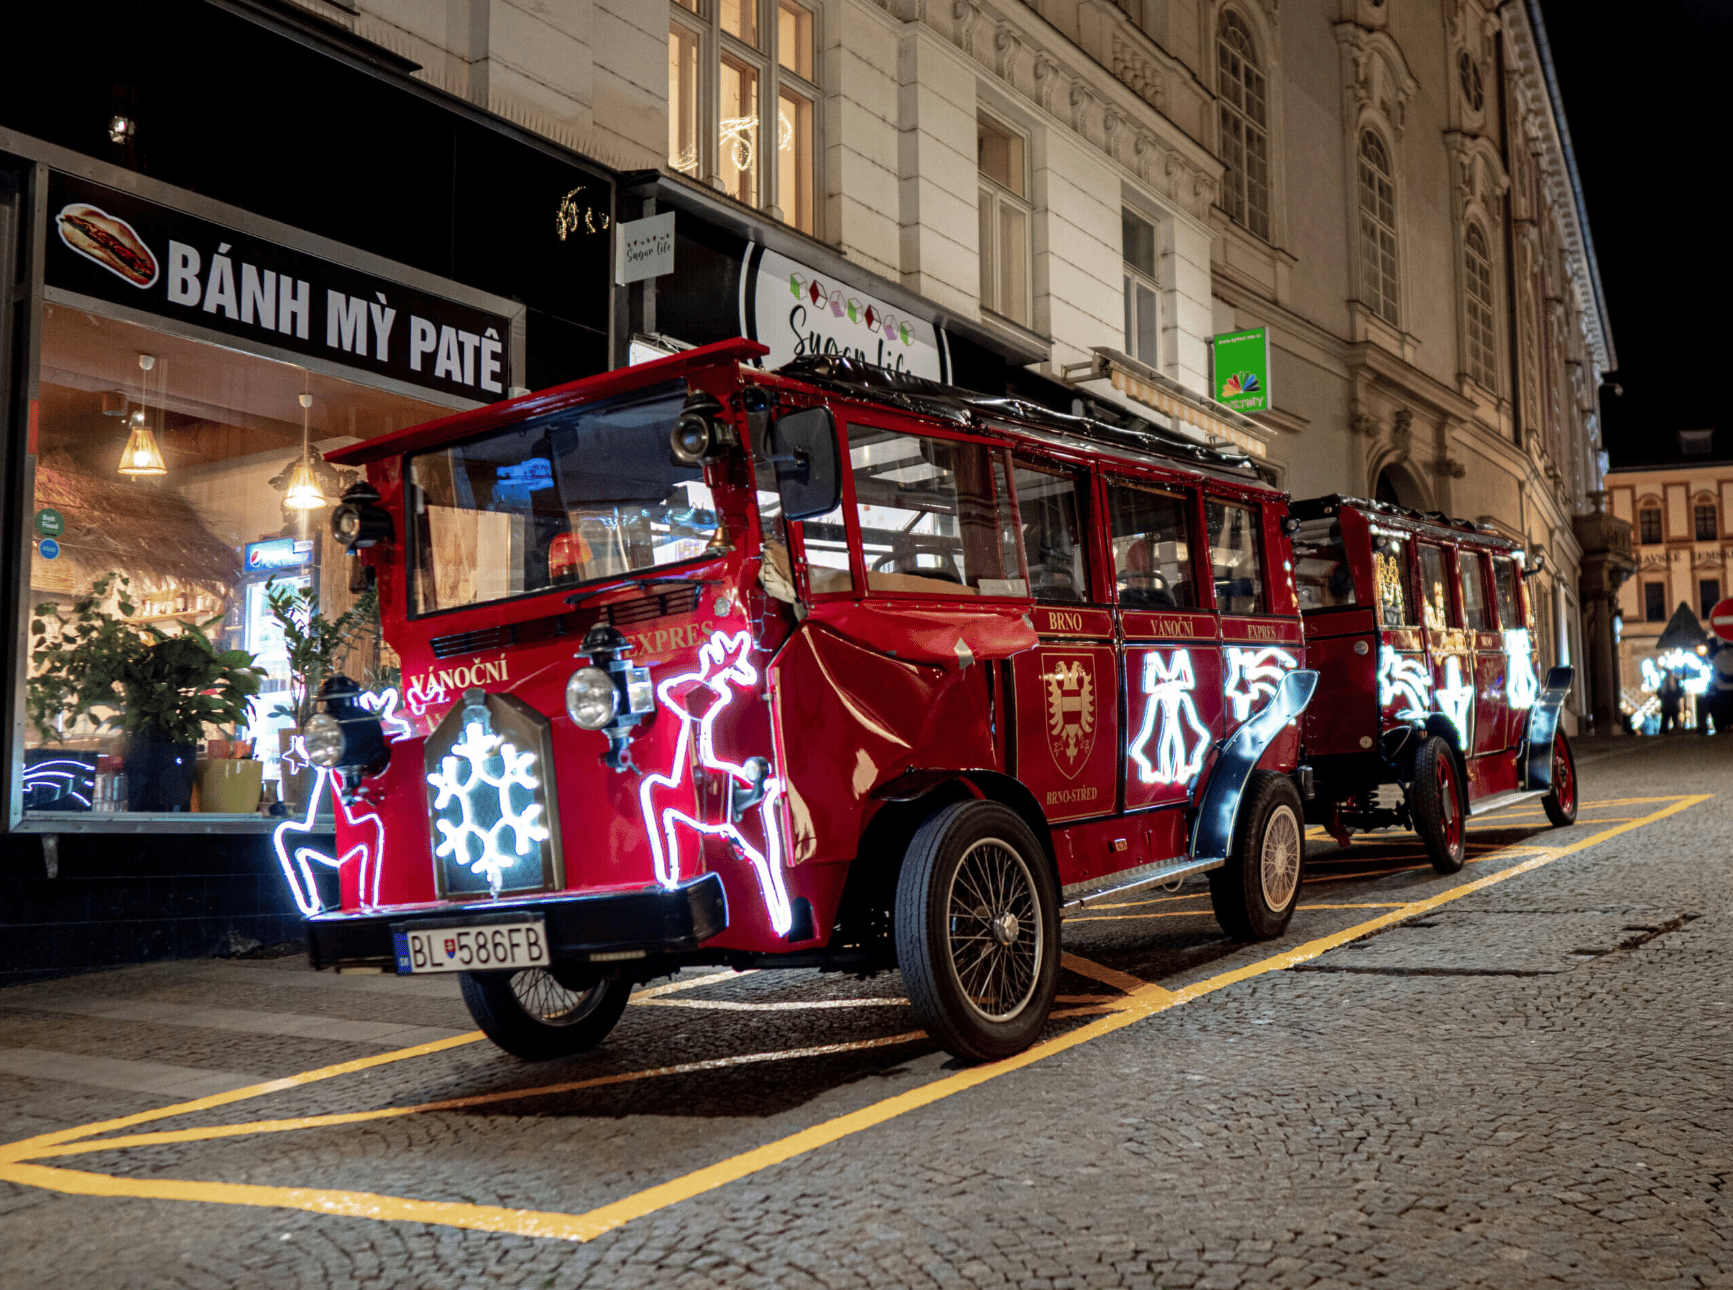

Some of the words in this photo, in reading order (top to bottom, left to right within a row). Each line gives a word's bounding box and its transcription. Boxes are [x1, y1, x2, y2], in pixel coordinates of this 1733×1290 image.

[626, 248, 654, 263] Sugar
[167, 239, 310, 340] BÁNH
[326, 289, 397, 362] MỲ
[410, 314, 502, 394] PATÊ
[1048, 612, 1083, 631] BRNO
[1150, 617, 1195, 637] VÁNOČNÍ
[1247, 624, 1277, 639] EXPRES
[410, 653, 509, 694] VÁNOČNÍ
[624, 620, 713, 659] EXPRES
[1046, 784, 1098, 805] BRNO-STŘED
[411, 935, 444, 968] BL
[456, 927, 544, 965] 586FB
